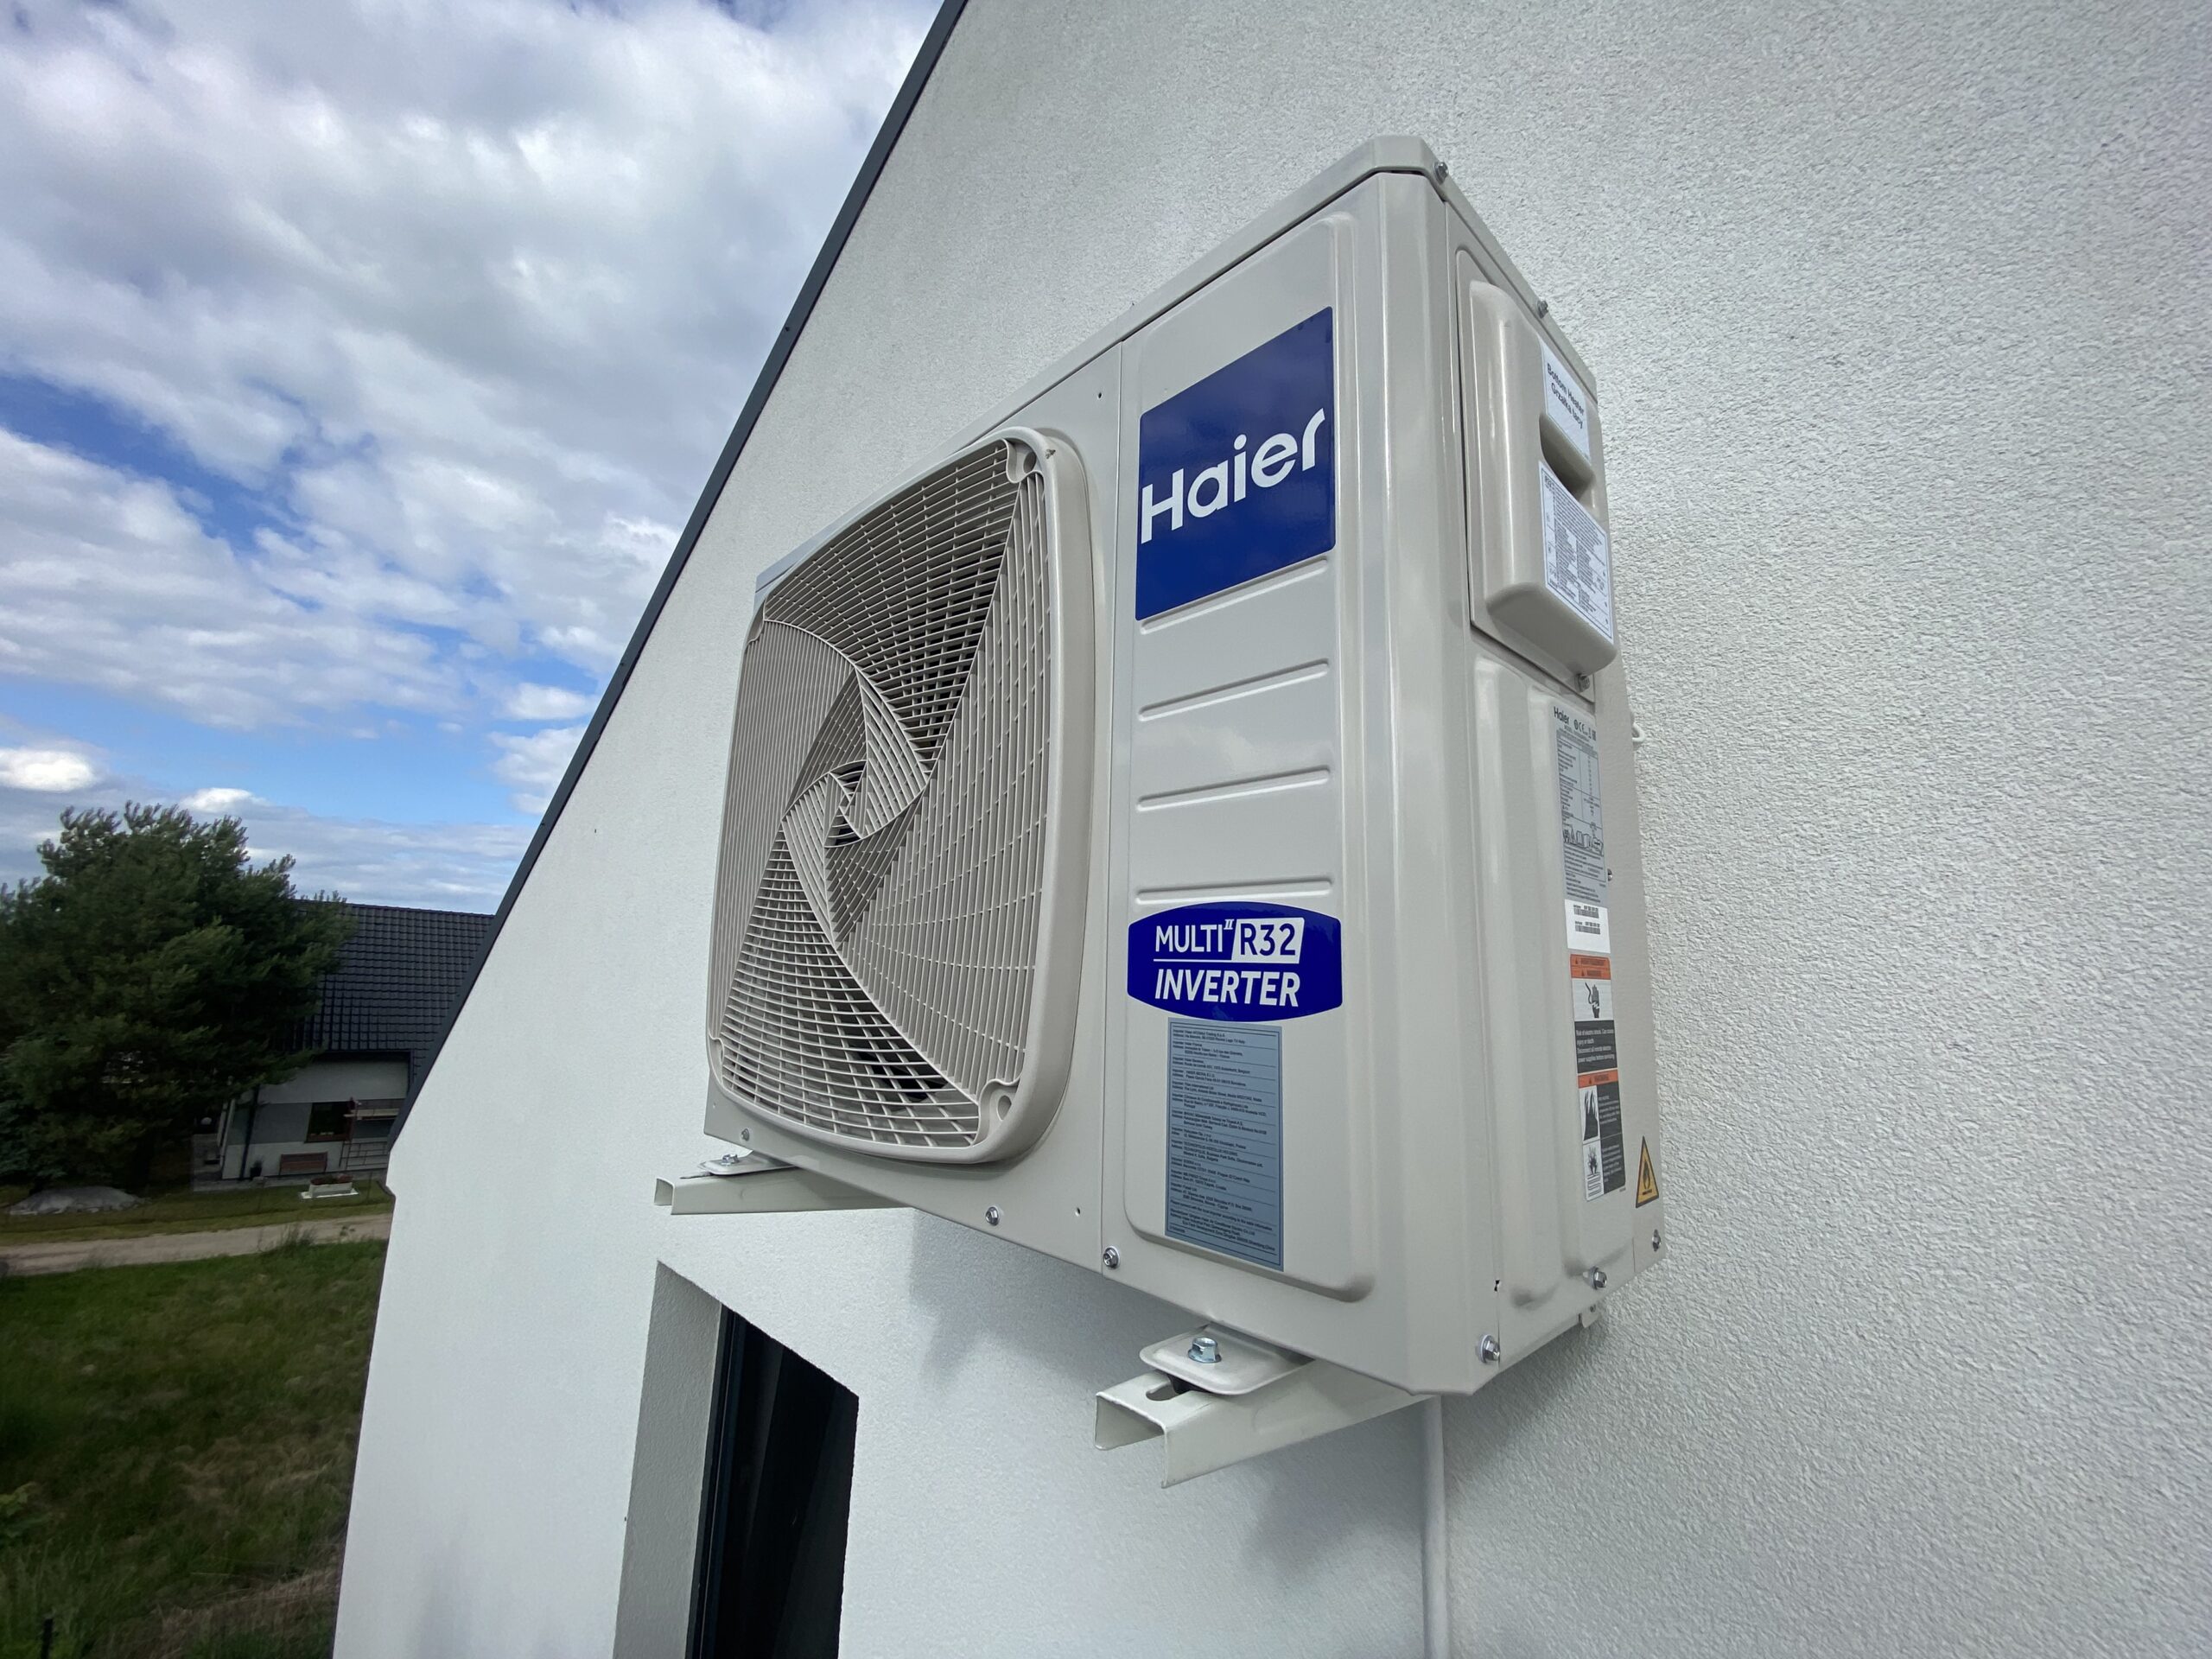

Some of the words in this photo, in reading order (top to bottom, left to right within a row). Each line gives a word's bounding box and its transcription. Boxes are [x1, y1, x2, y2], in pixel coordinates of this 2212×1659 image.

[1141, 407, 1325, 545] Haier
[1554, 705, 1570, 725] Haier
[1154, 924, 1224, 953] MULTI
[1240, 922, 1297, 957] R32
[1154, 968, 1301, 1007] INVERTER
